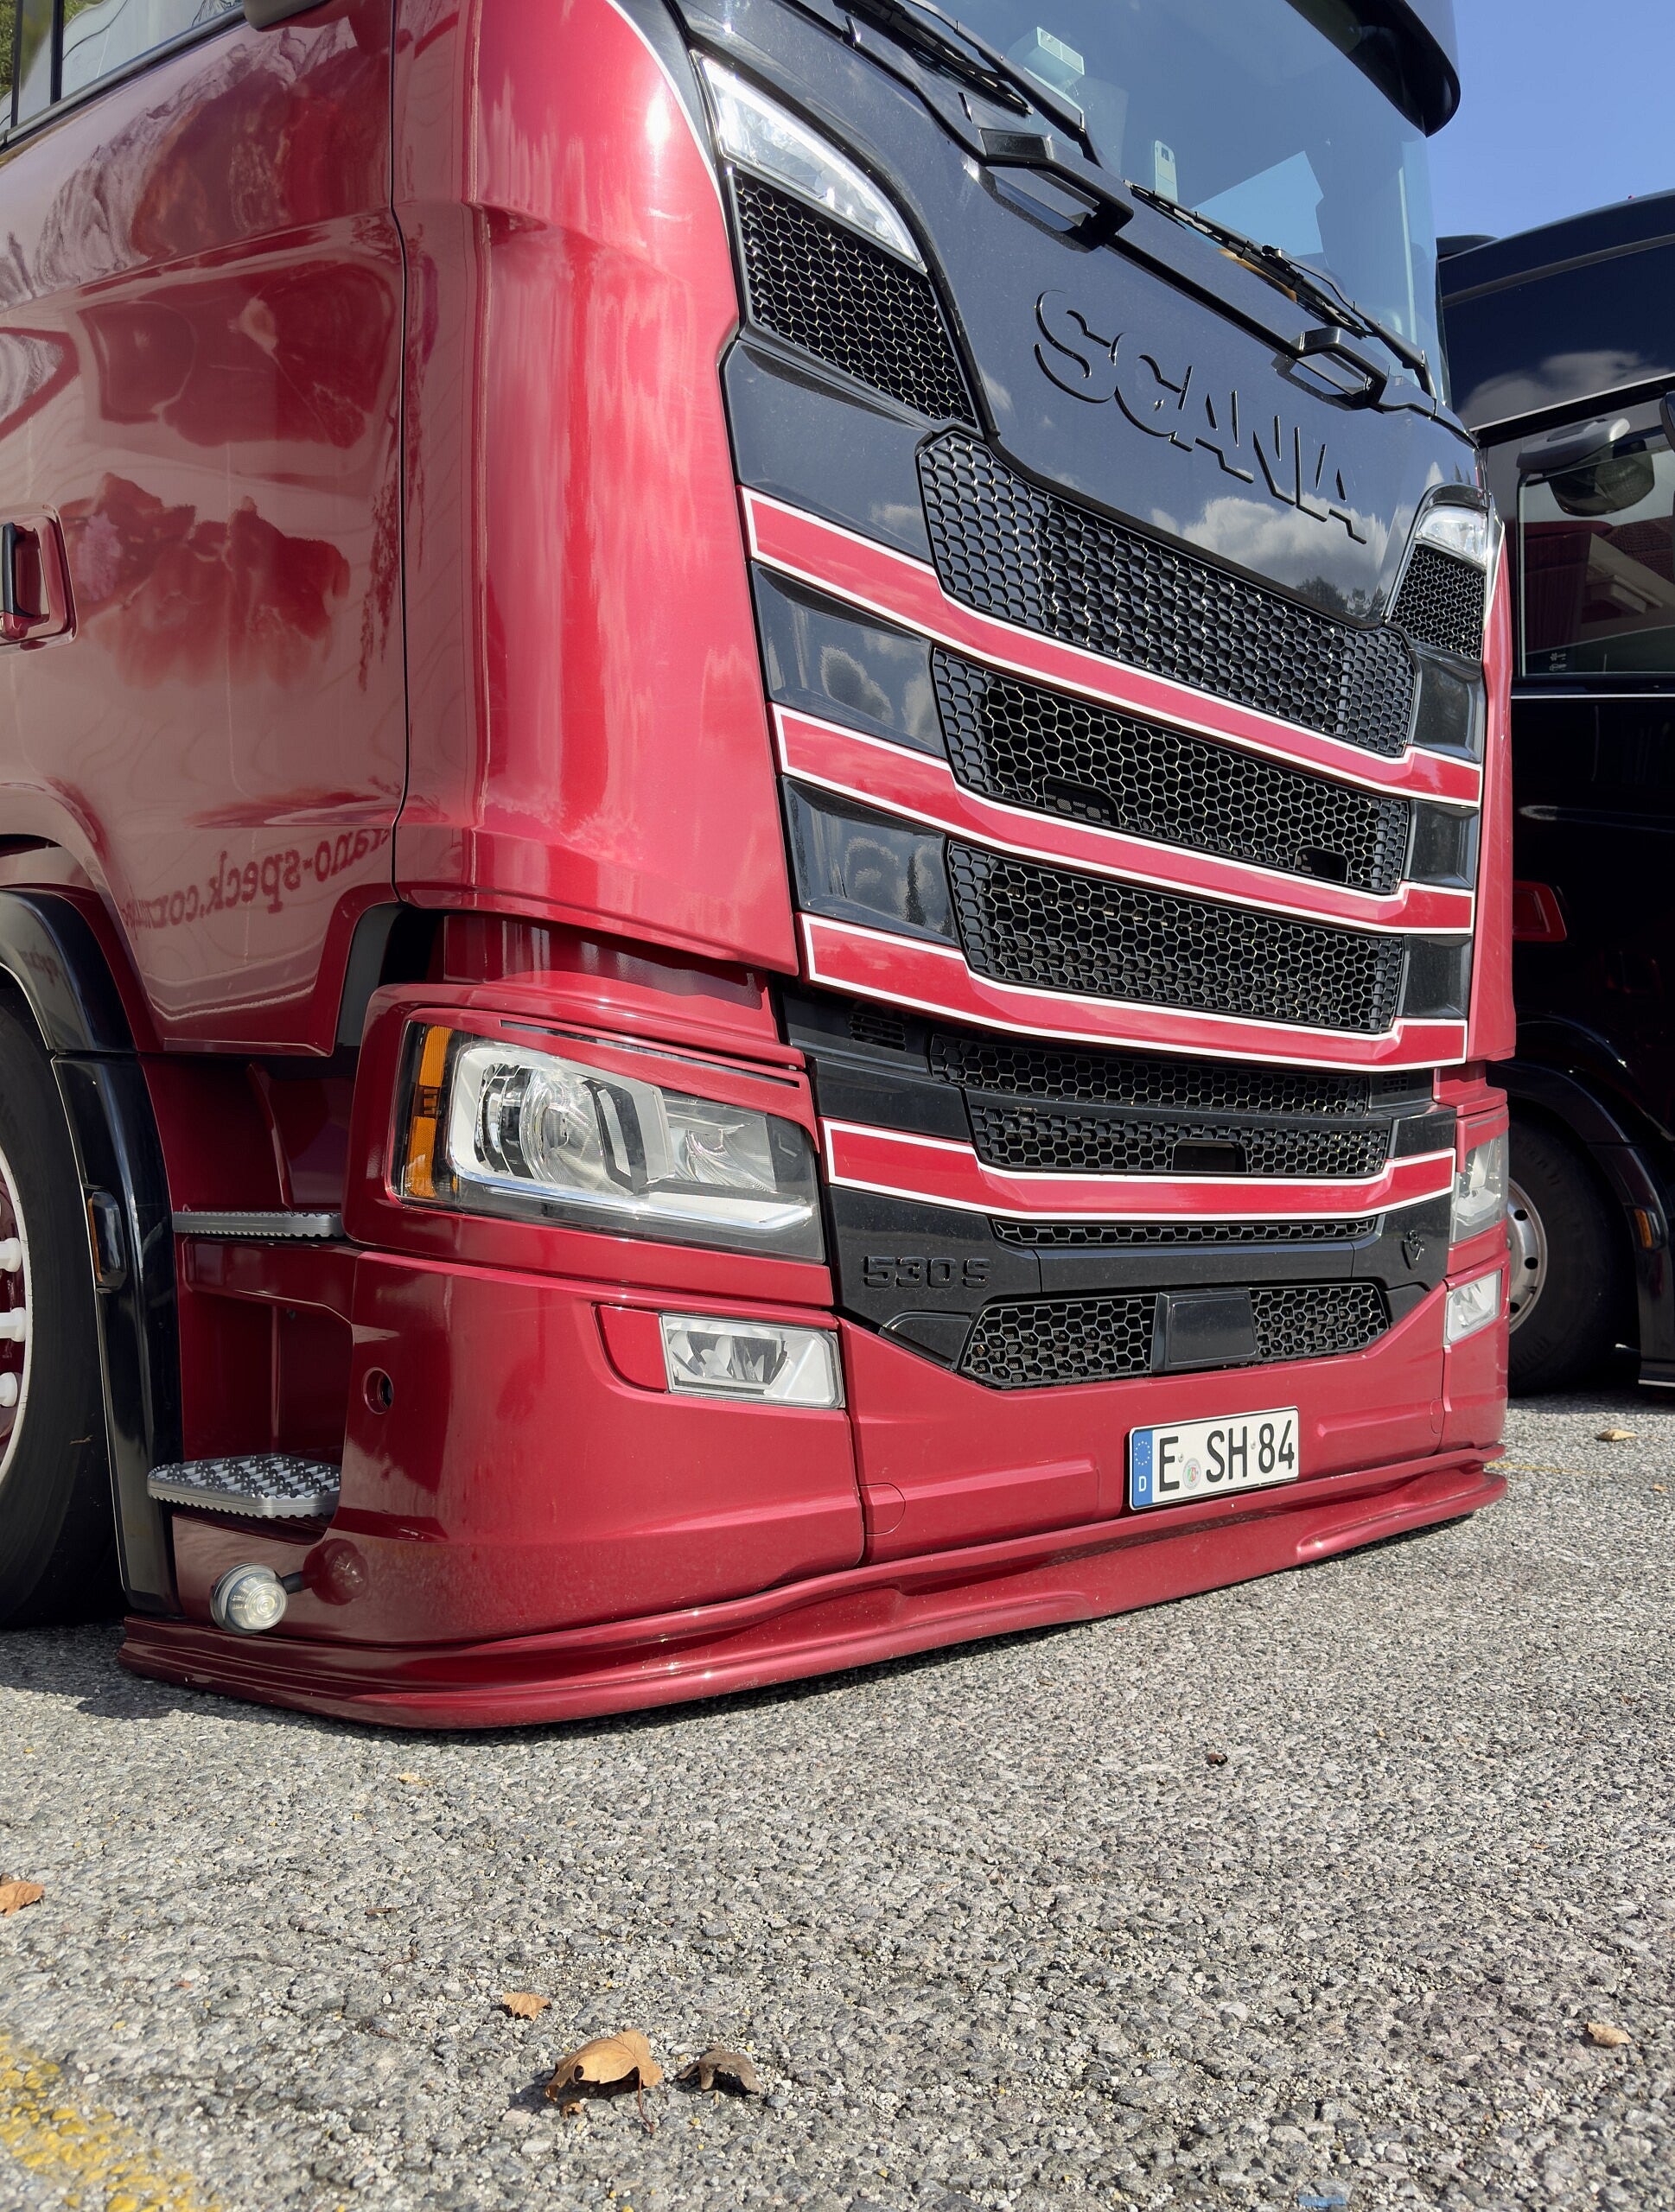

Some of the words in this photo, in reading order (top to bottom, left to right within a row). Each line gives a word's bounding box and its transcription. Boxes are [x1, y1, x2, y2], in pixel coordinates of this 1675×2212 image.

[1035, 289, 1367, 545] SCANIA
[863, 1255, 958, 1289] 530
[961, 1257, 991, 1289] S
[1159, 1435, 1181, 1492] E
[1206, 1426, 1248, 1483] SH
[1258, 1420, 1295, 1473] 84
[1138, 1475, 1147, 1492] D
